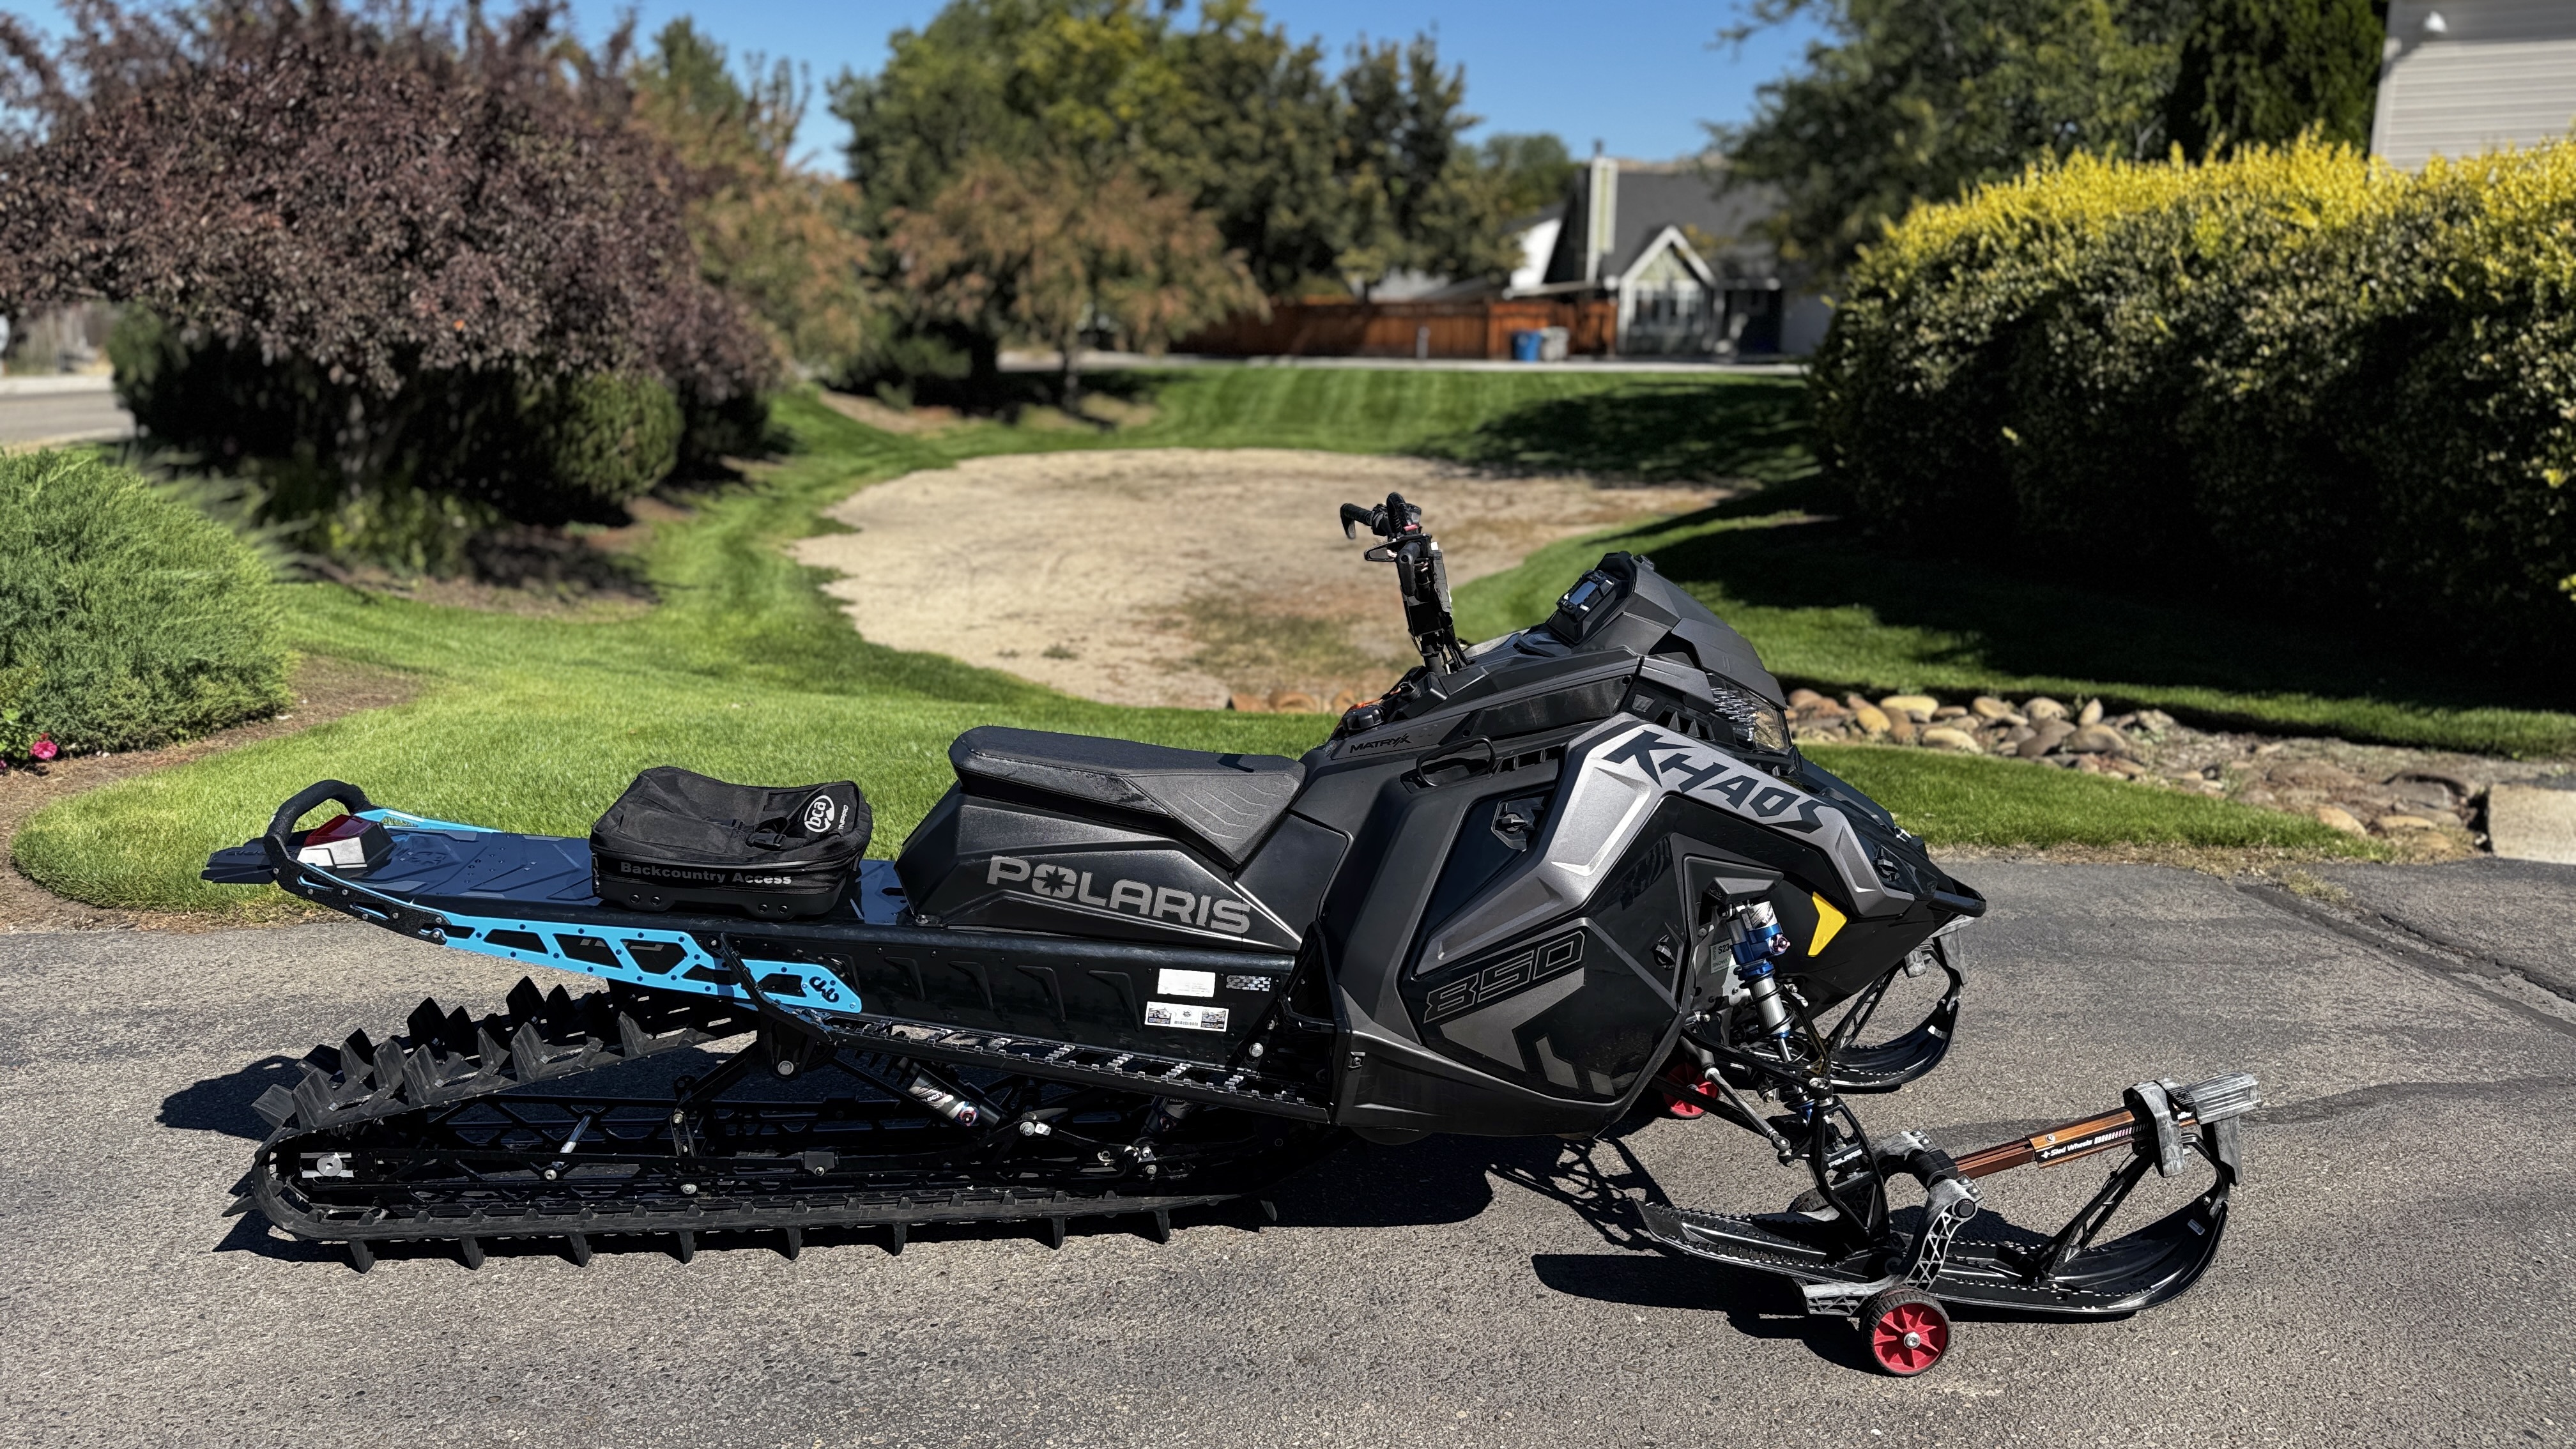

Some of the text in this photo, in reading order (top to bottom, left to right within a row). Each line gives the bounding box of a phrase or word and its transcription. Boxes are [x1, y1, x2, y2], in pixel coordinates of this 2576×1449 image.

[1349, 733, 1411, 753] MATRYX
[1602, 730, 1832, 833] KHAOS
[620, 862, 792, 885] Backcountry Access
[986, 855, 1251, 934] POLARIS
[1423, 930, 1586, 1023] 850
[2050, 1139, 2094, 1156] Sled Wheels
